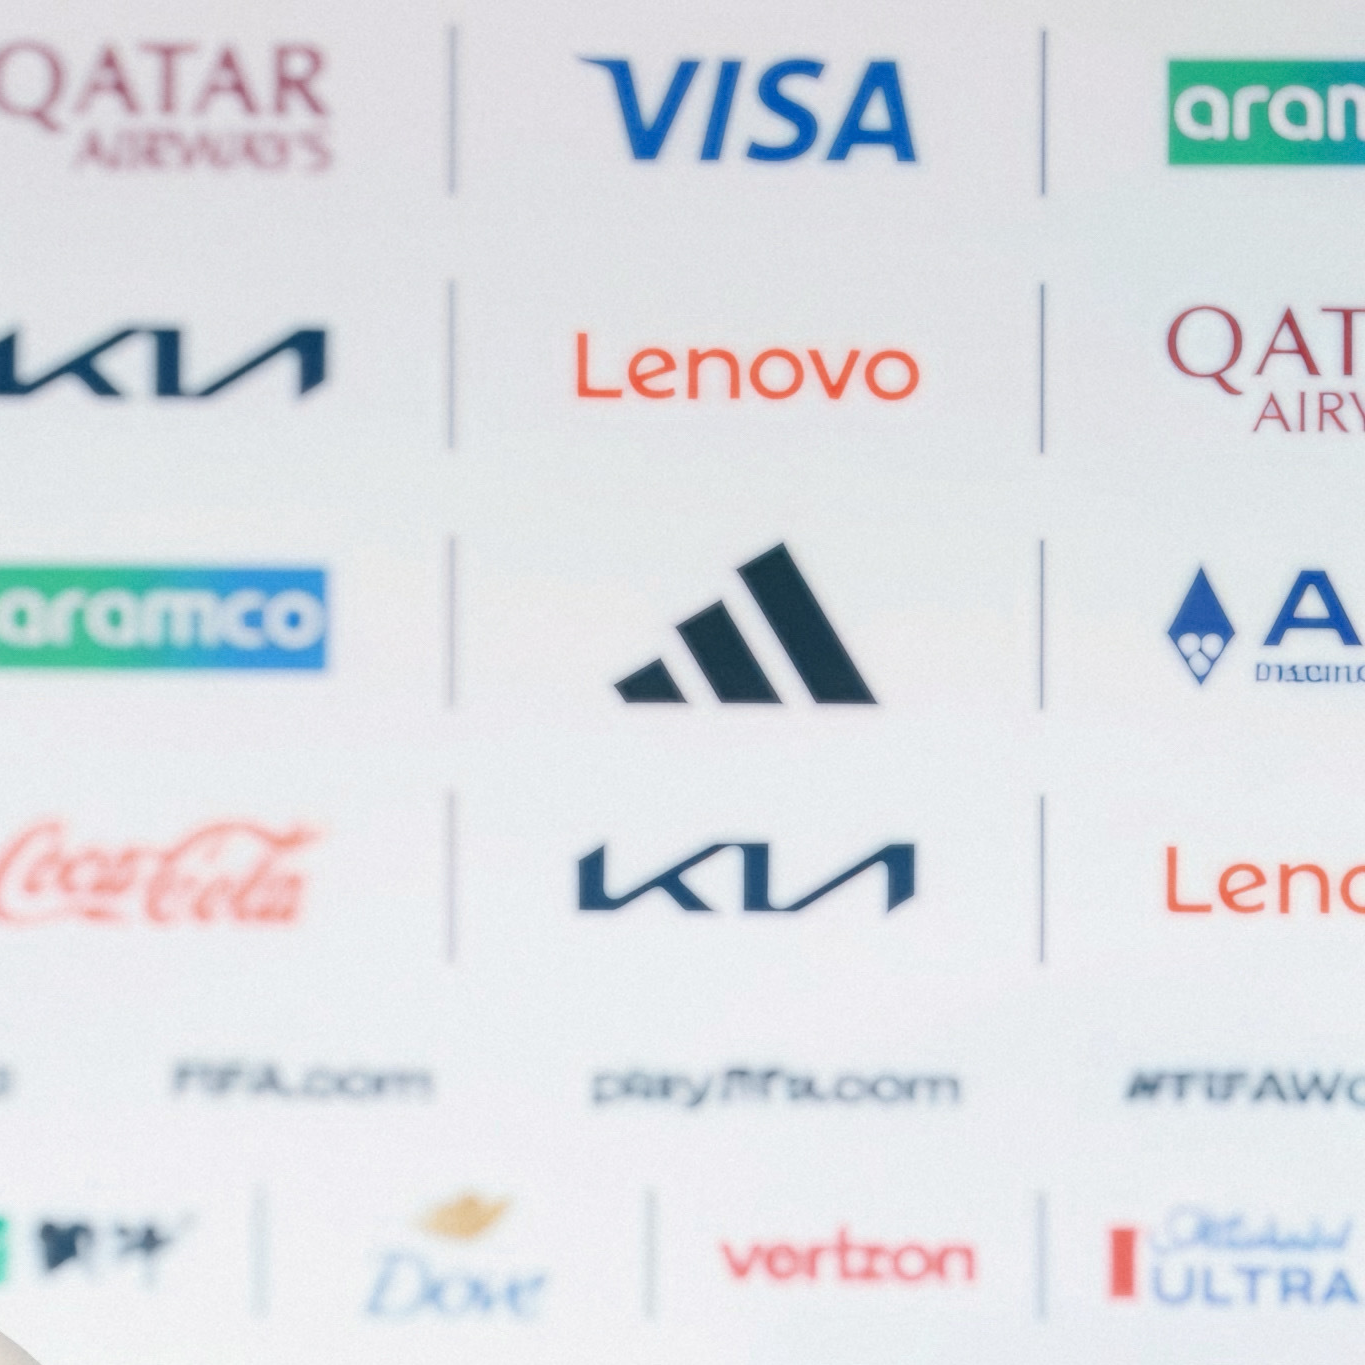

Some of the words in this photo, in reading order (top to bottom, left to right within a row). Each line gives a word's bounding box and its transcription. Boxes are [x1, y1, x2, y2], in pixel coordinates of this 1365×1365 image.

[578, 56, 917, 163] VISA
[78, 127, 332, 171] AIRWAYS
[576, 332, 920, 401] Lenovo
[1167, 305, 1365, 395] QAT
[1153, 1266, 1360, 1305] ULTRA
